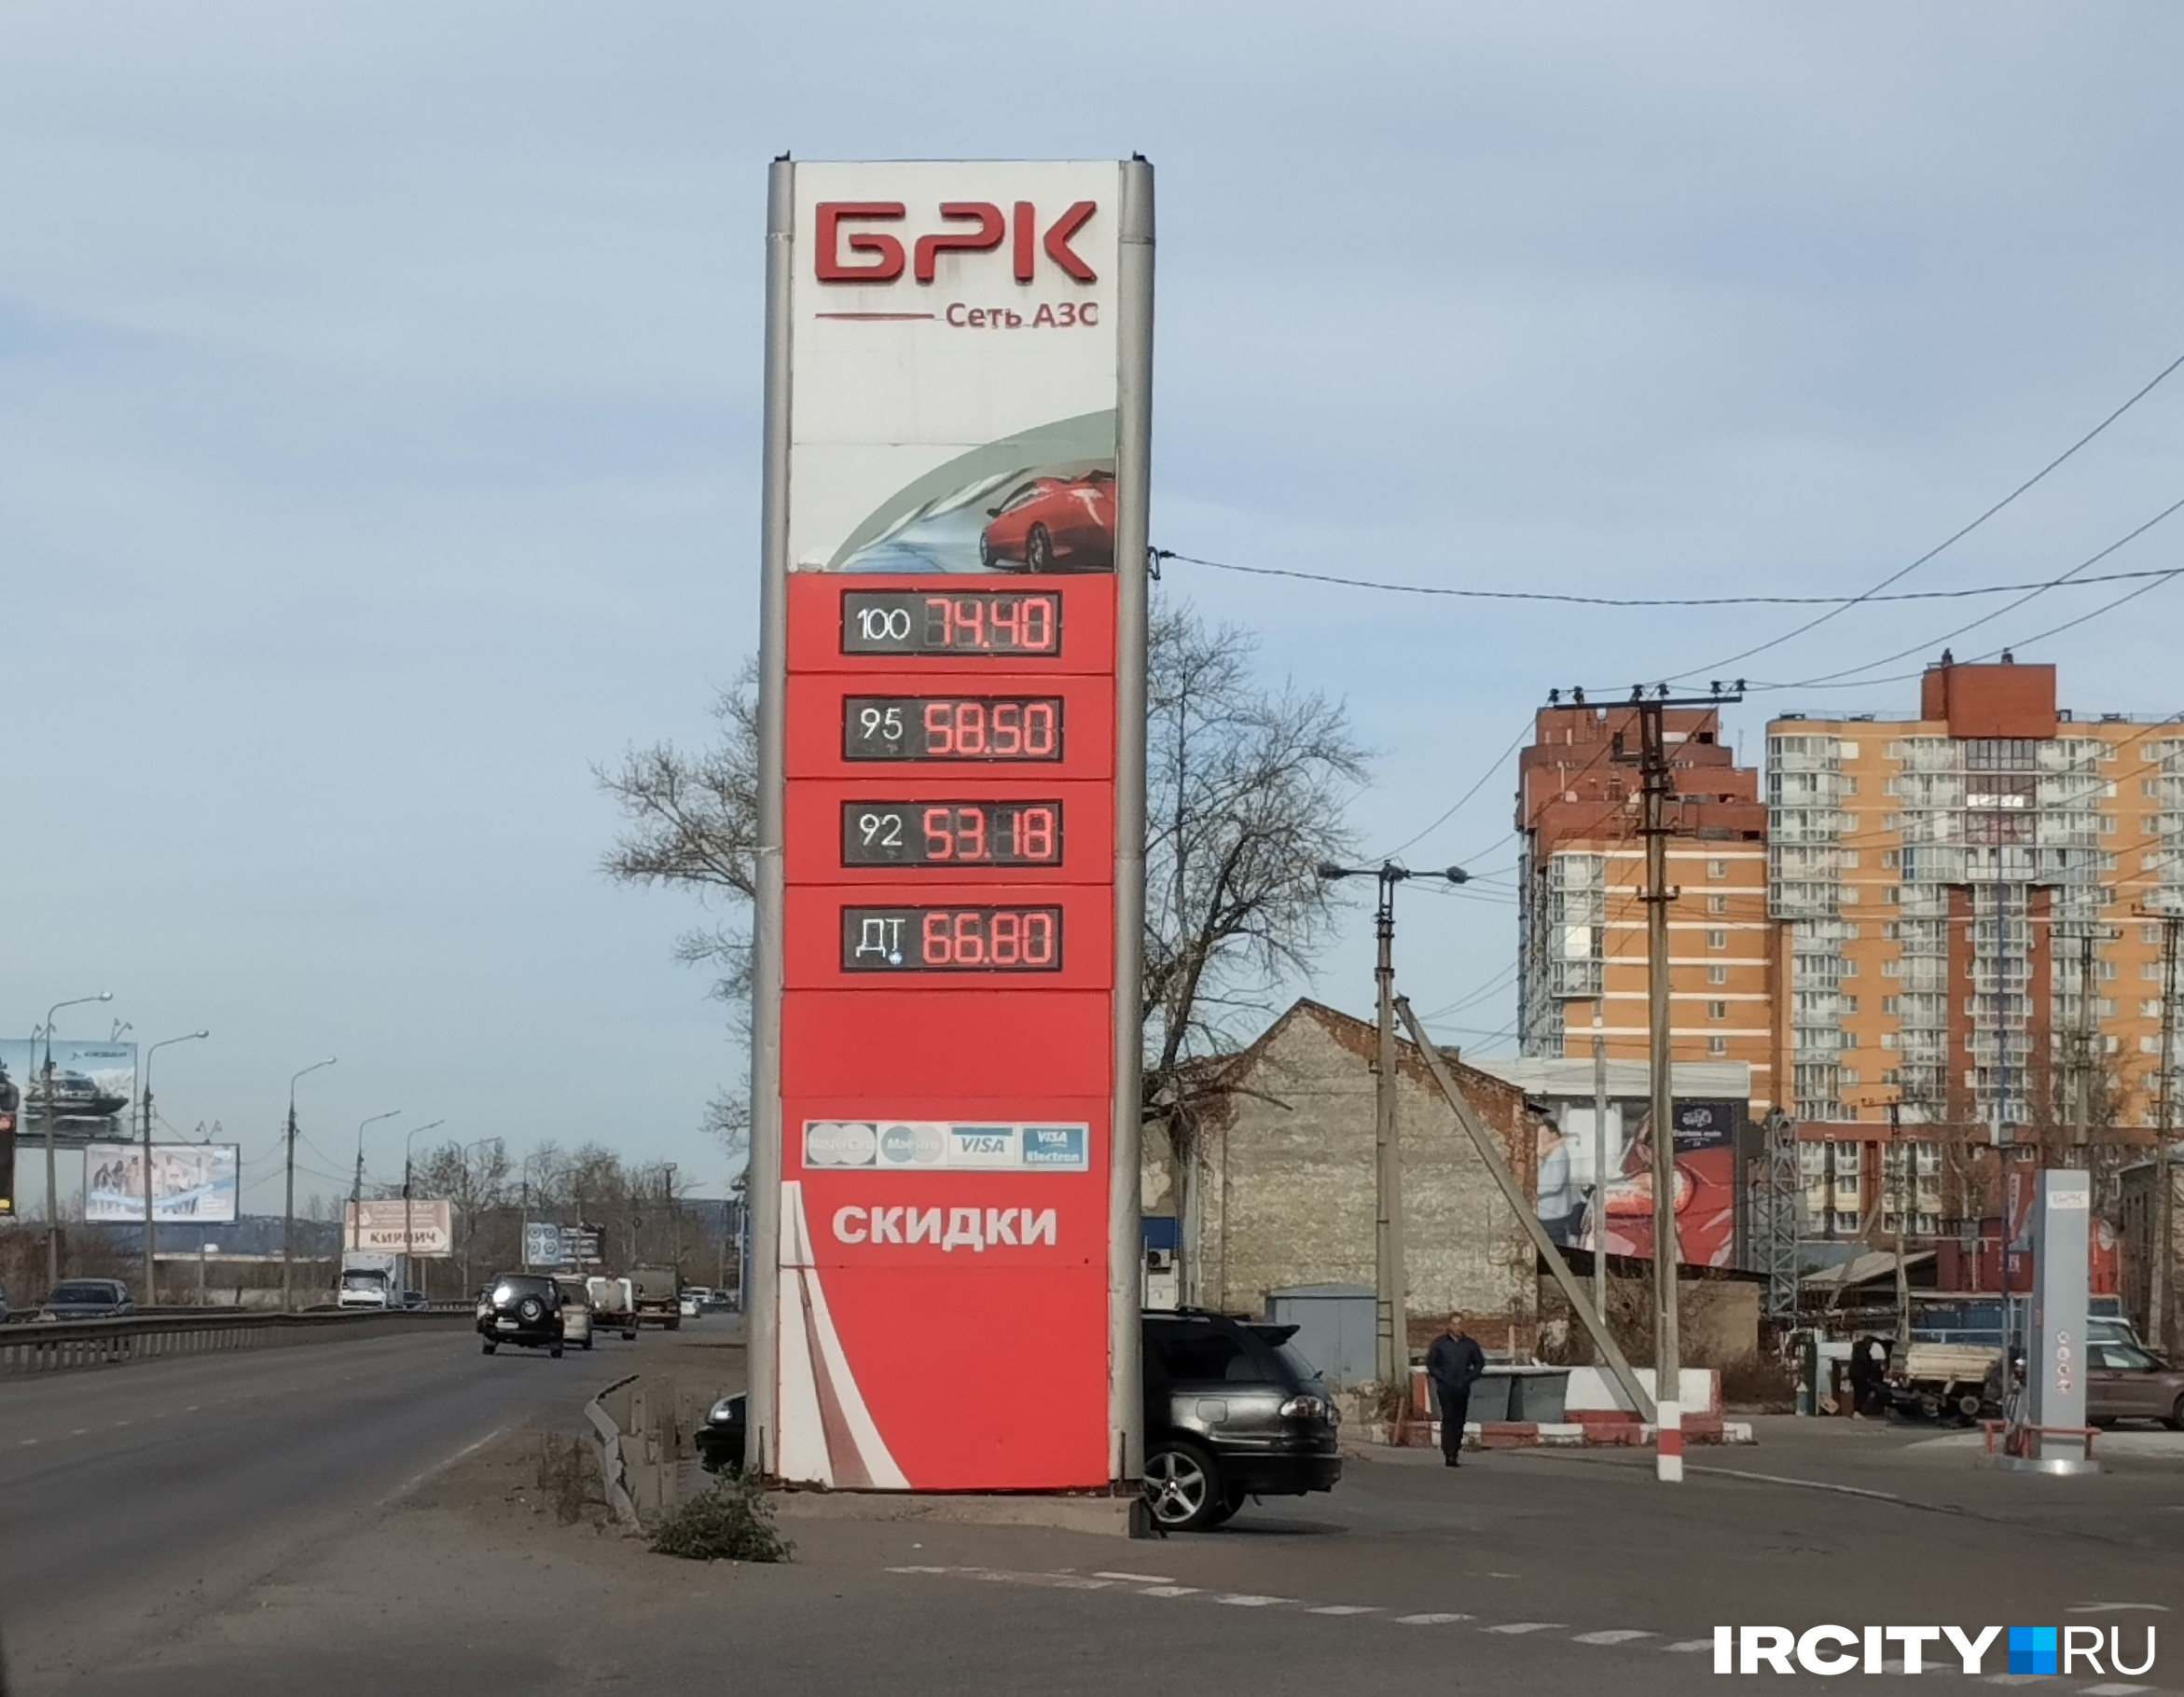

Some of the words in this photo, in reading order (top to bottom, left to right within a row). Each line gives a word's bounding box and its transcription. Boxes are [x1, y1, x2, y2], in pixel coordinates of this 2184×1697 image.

[815, 201, 1099, 283] БРК
[946, 302, 1024, 328] Сеть
[1031, 302, 1099, 327] АЗС
[857, 608, 911, 641] 100
[925, 598, 1052, 648] 74.40
[860, 707, 905, 740] 95
[923, 702, 1054, 754] 58.50
[859, 813, 903, 847] 92
[922, 807, 1054, 860] 53.18
[855, 917, 906, 959] ДТ
[922, 912, 1052, 965] 66.80
[961, 1137, 1005, 1153] VISA
[1026, 1150, 1080, 1163] Electron
[1036, 1130, 1069, 1143] VISA
[833, 1206, 1057, 1252] СКИДКИ
